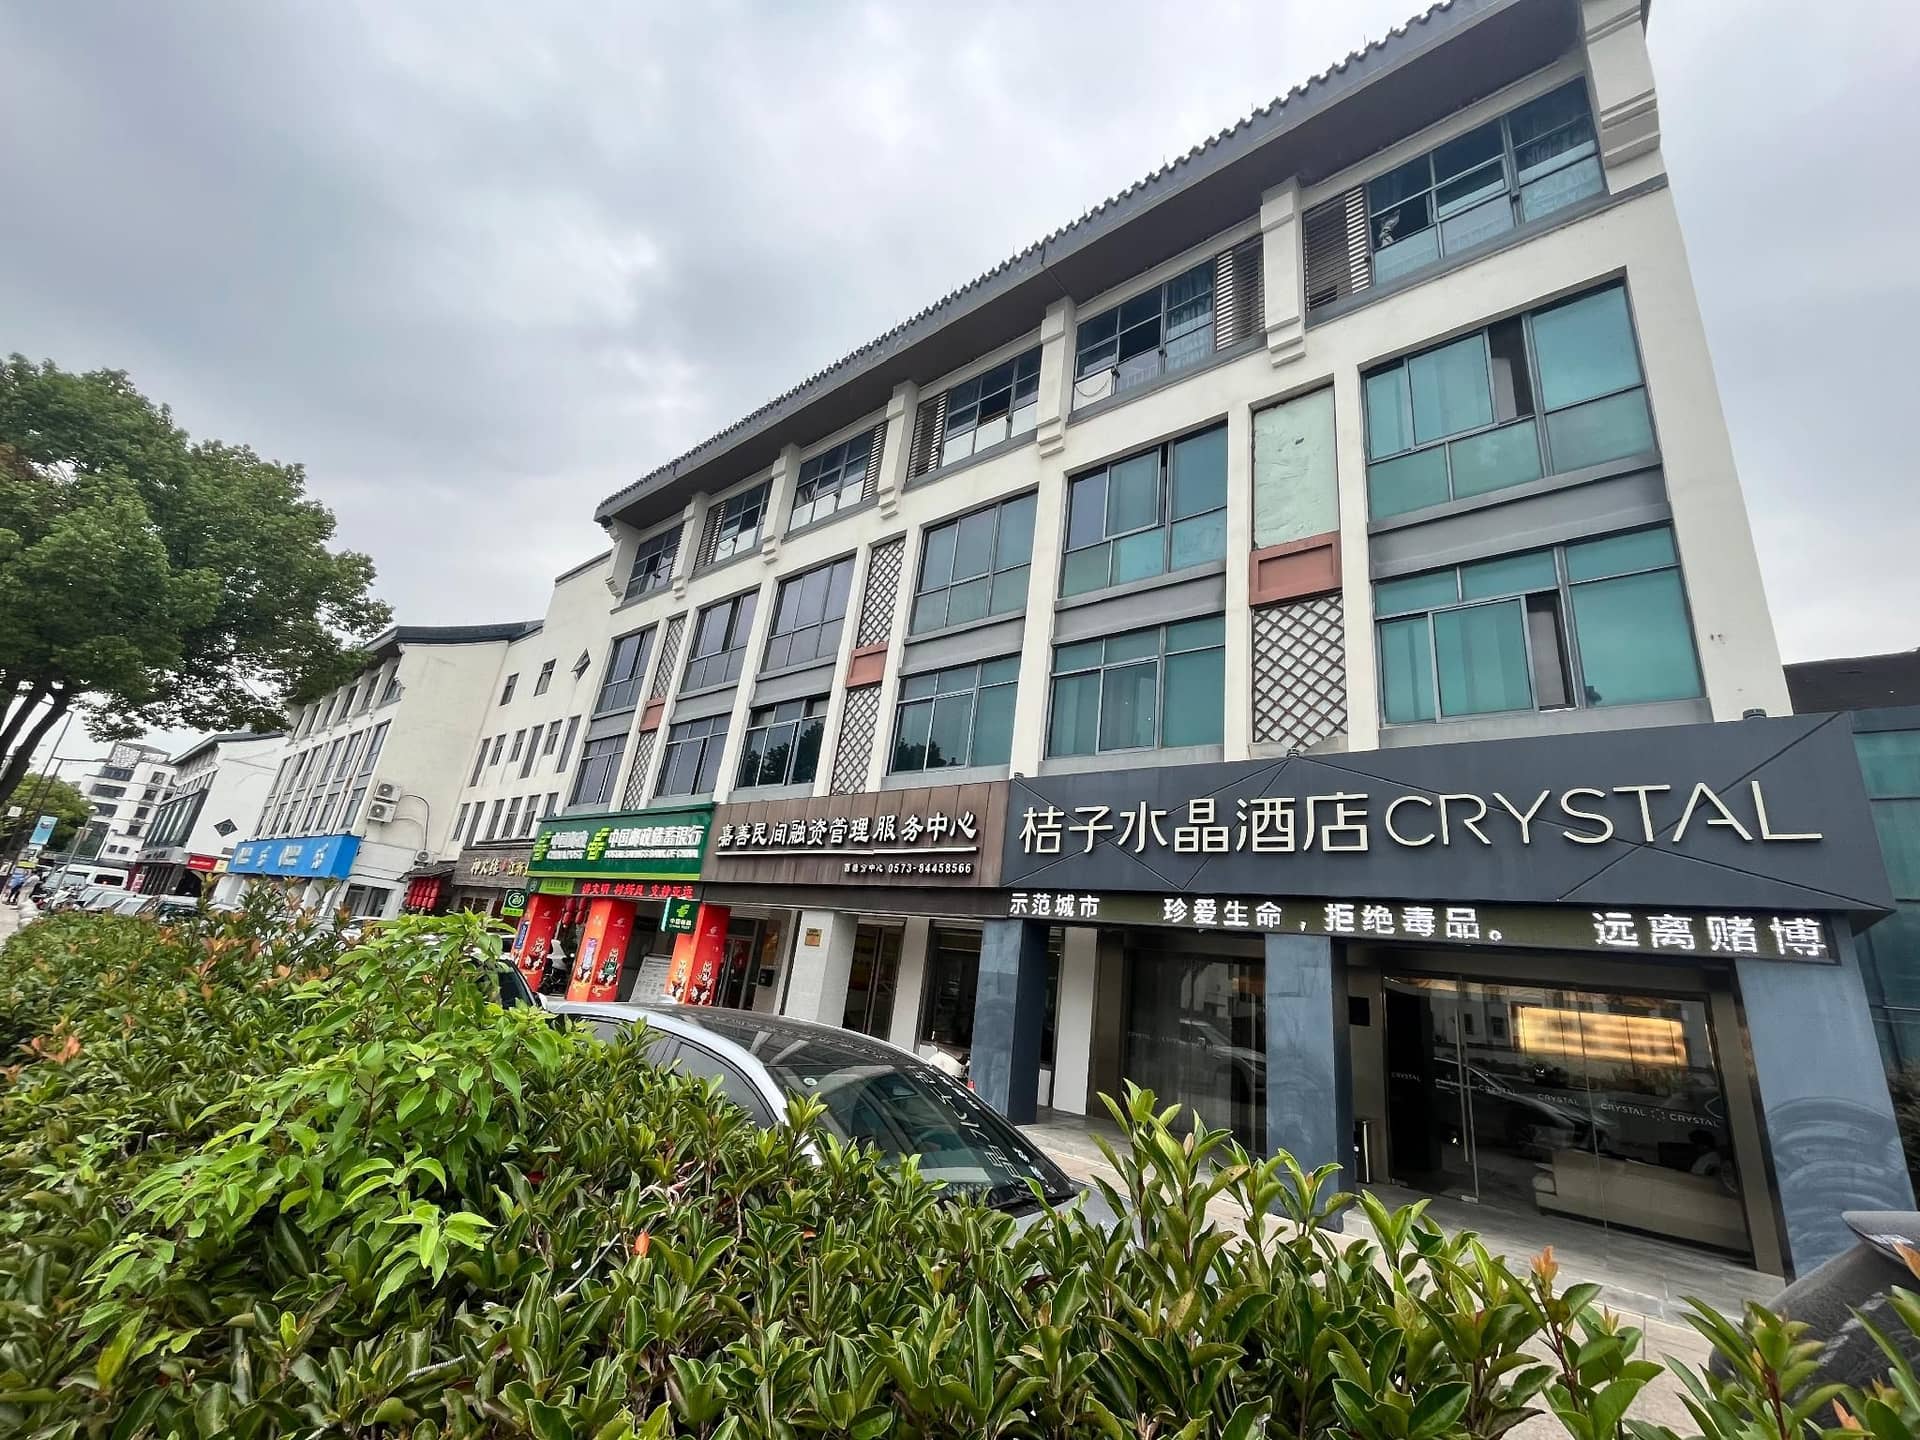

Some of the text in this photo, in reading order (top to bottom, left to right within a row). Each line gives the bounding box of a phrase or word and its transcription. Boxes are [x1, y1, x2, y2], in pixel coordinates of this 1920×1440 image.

[718, 811, 977, 848] 嘉善民间融资管理服务中心
[1018, 780, 1823, 854] 桔子水晶酒店 CRYSTAL
[888, 862, 972, 874] 0573-84458566
[1010, 893, 1100, 917] 示范城市
[1592, 912, 1827, 957] 远离赌博
[1600, 1103, 1721, 1128] CRYSTAL CRYSTAL
